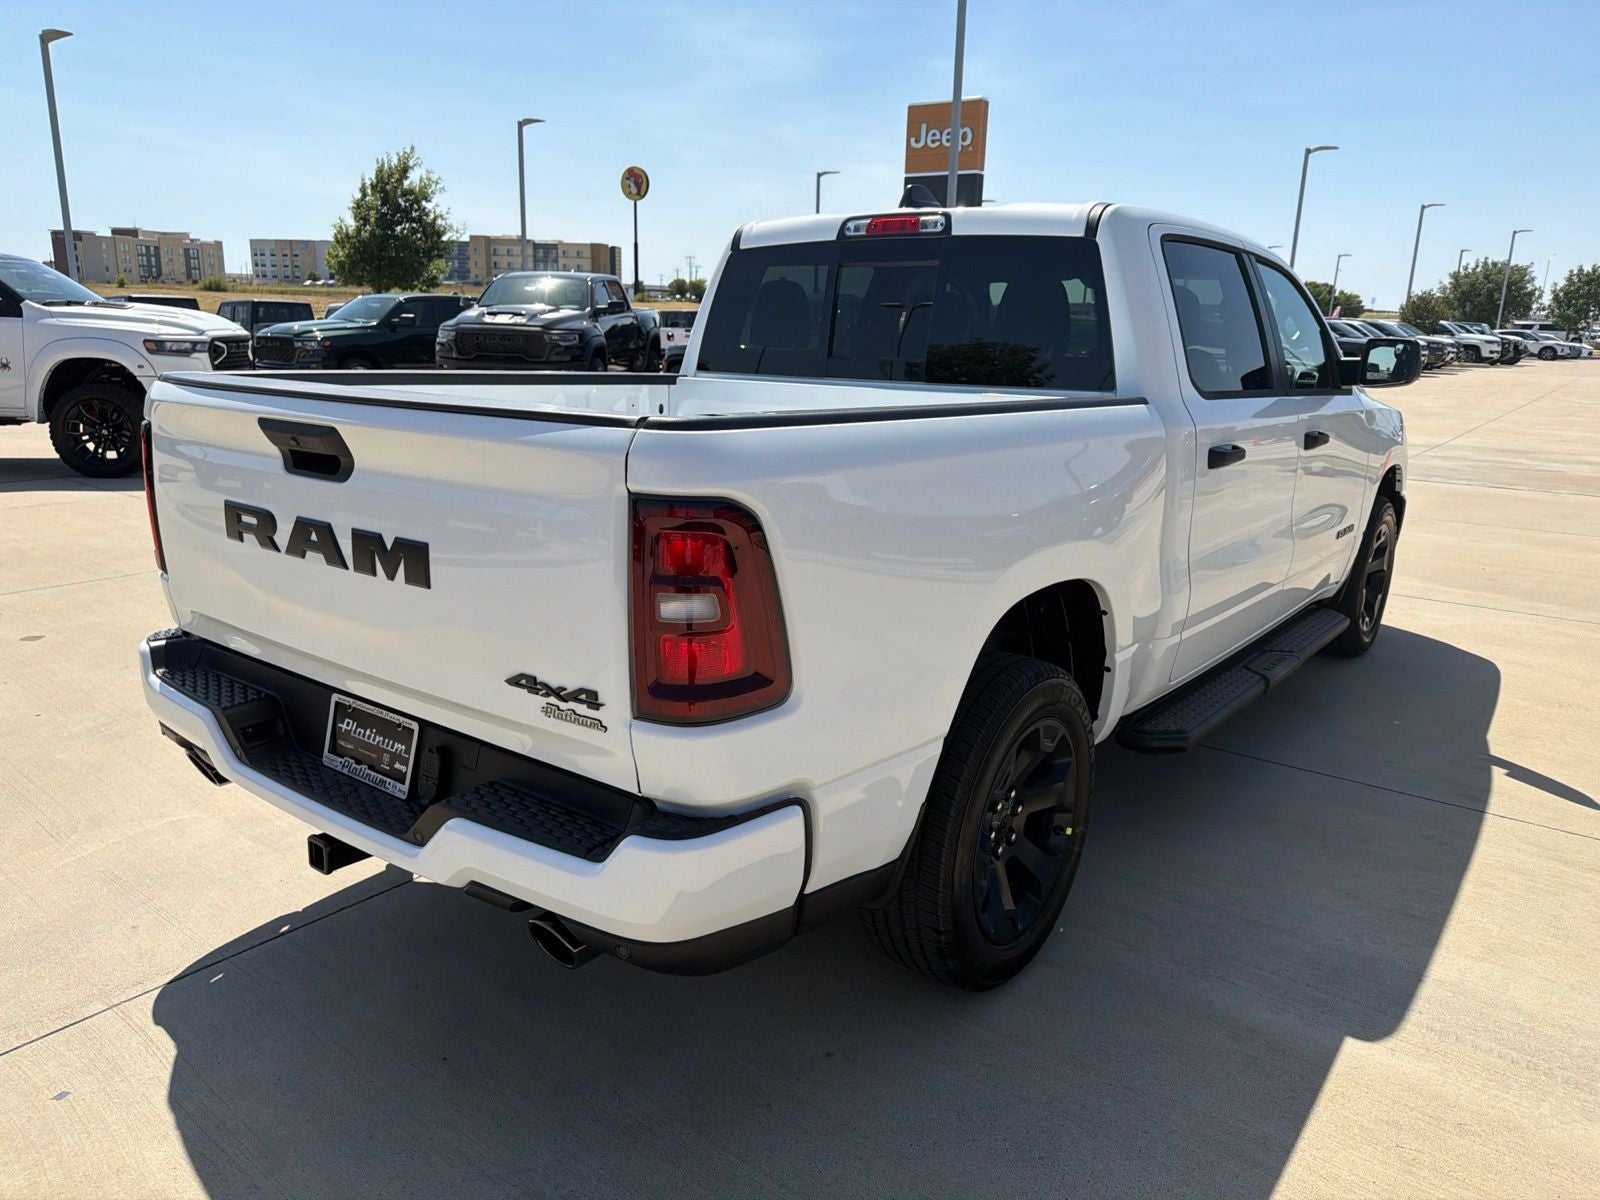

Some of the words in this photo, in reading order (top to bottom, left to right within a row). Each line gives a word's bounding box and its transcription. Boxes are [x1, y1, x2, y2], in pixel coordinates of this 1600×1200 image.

[910, 122, 973, 152] Jeep
[224, 499, 431, 590] RAM
[541, 703, 607, 732] Platinum
[338, 718, 409, 758] Platinum
[339, 758, 391, 790] Platinum
[393, 760, 407, 773] Jeep
